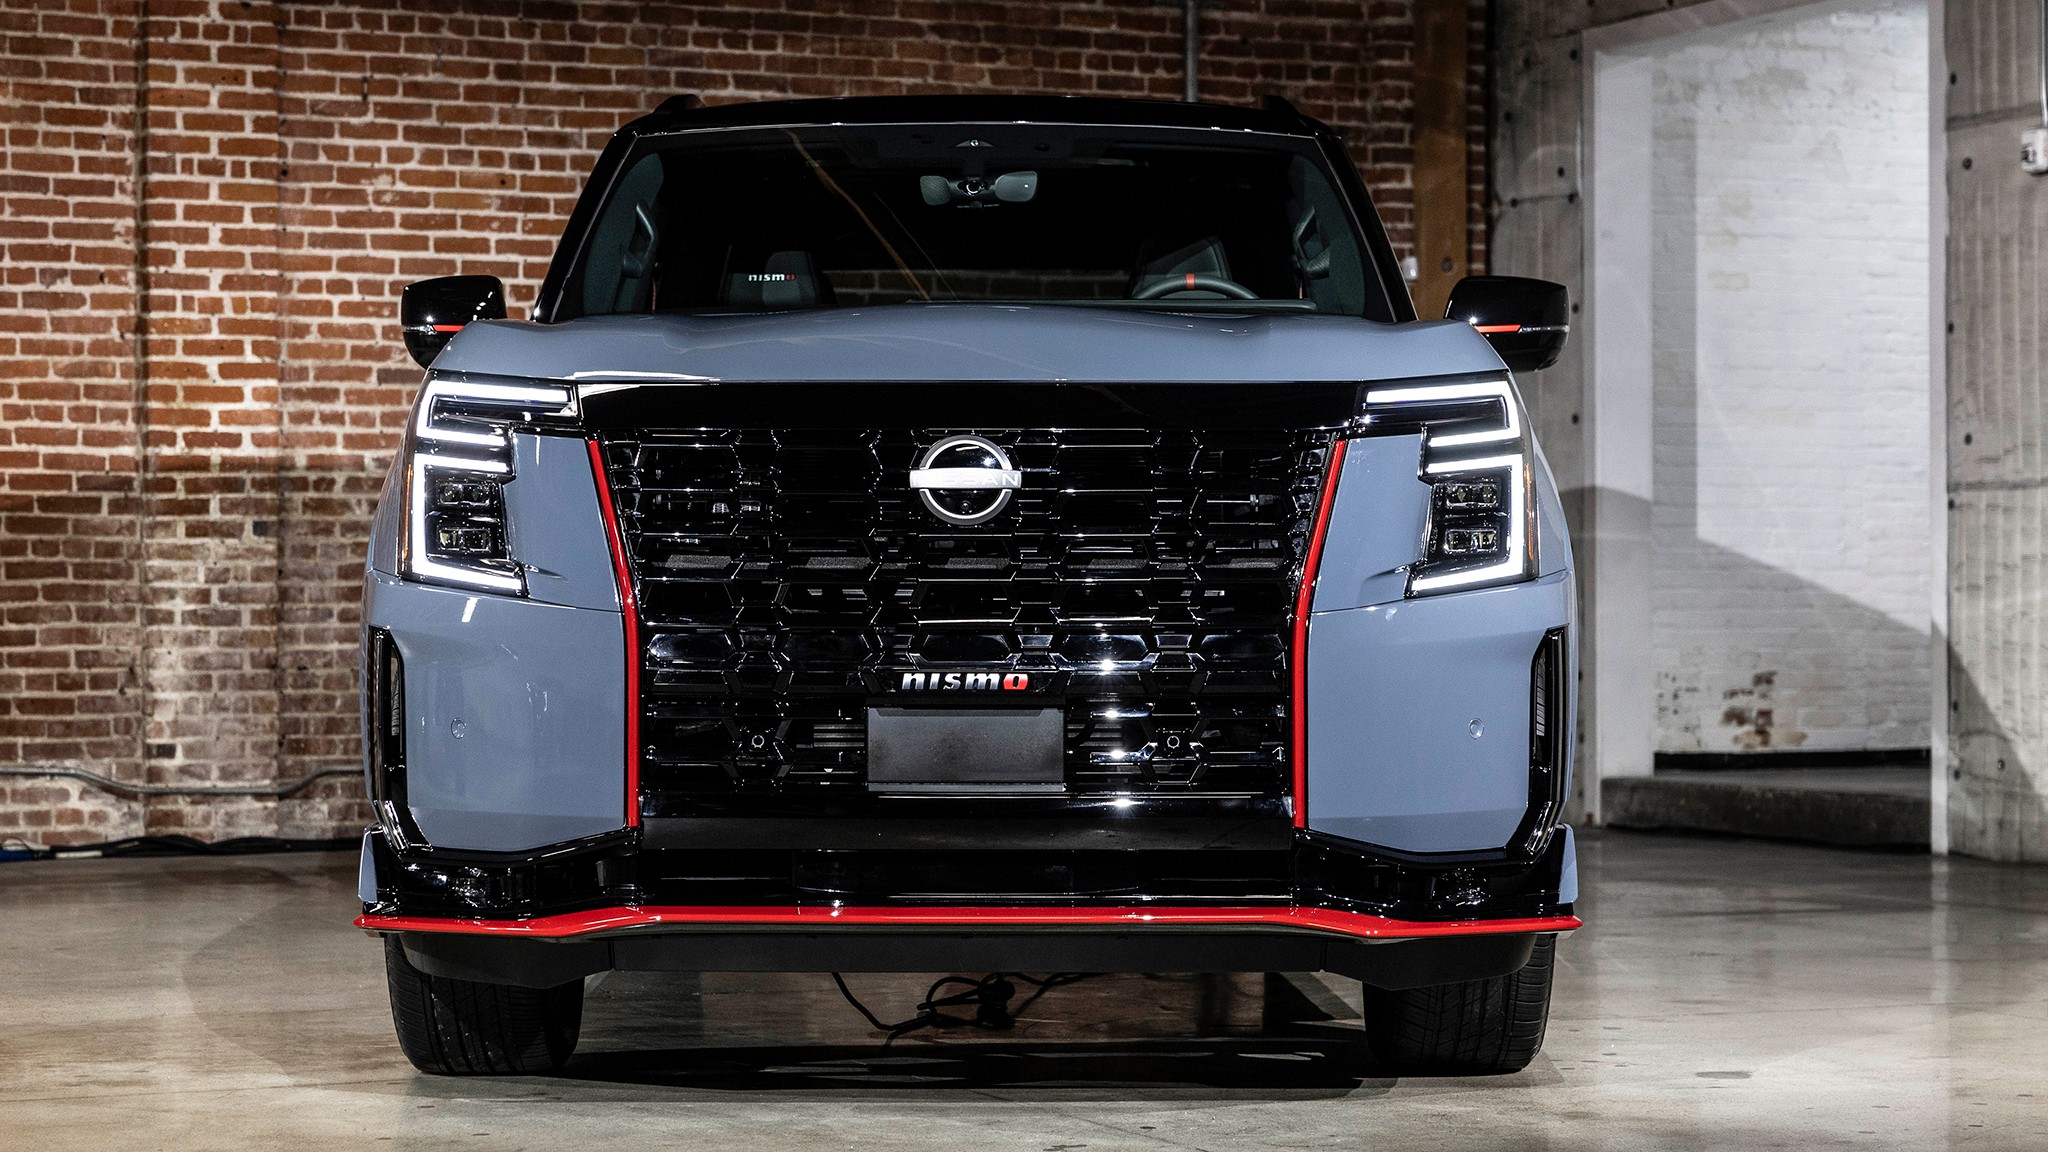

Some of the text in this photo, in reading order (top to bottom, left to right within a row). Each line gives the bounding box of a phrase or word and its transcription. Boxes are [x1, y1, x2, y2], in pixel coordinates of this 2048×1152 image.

[748, 273, 796, 282] nismo
[913, 472, 1018, 486] SSAN
[902, 672, 1029, 690] nismo
